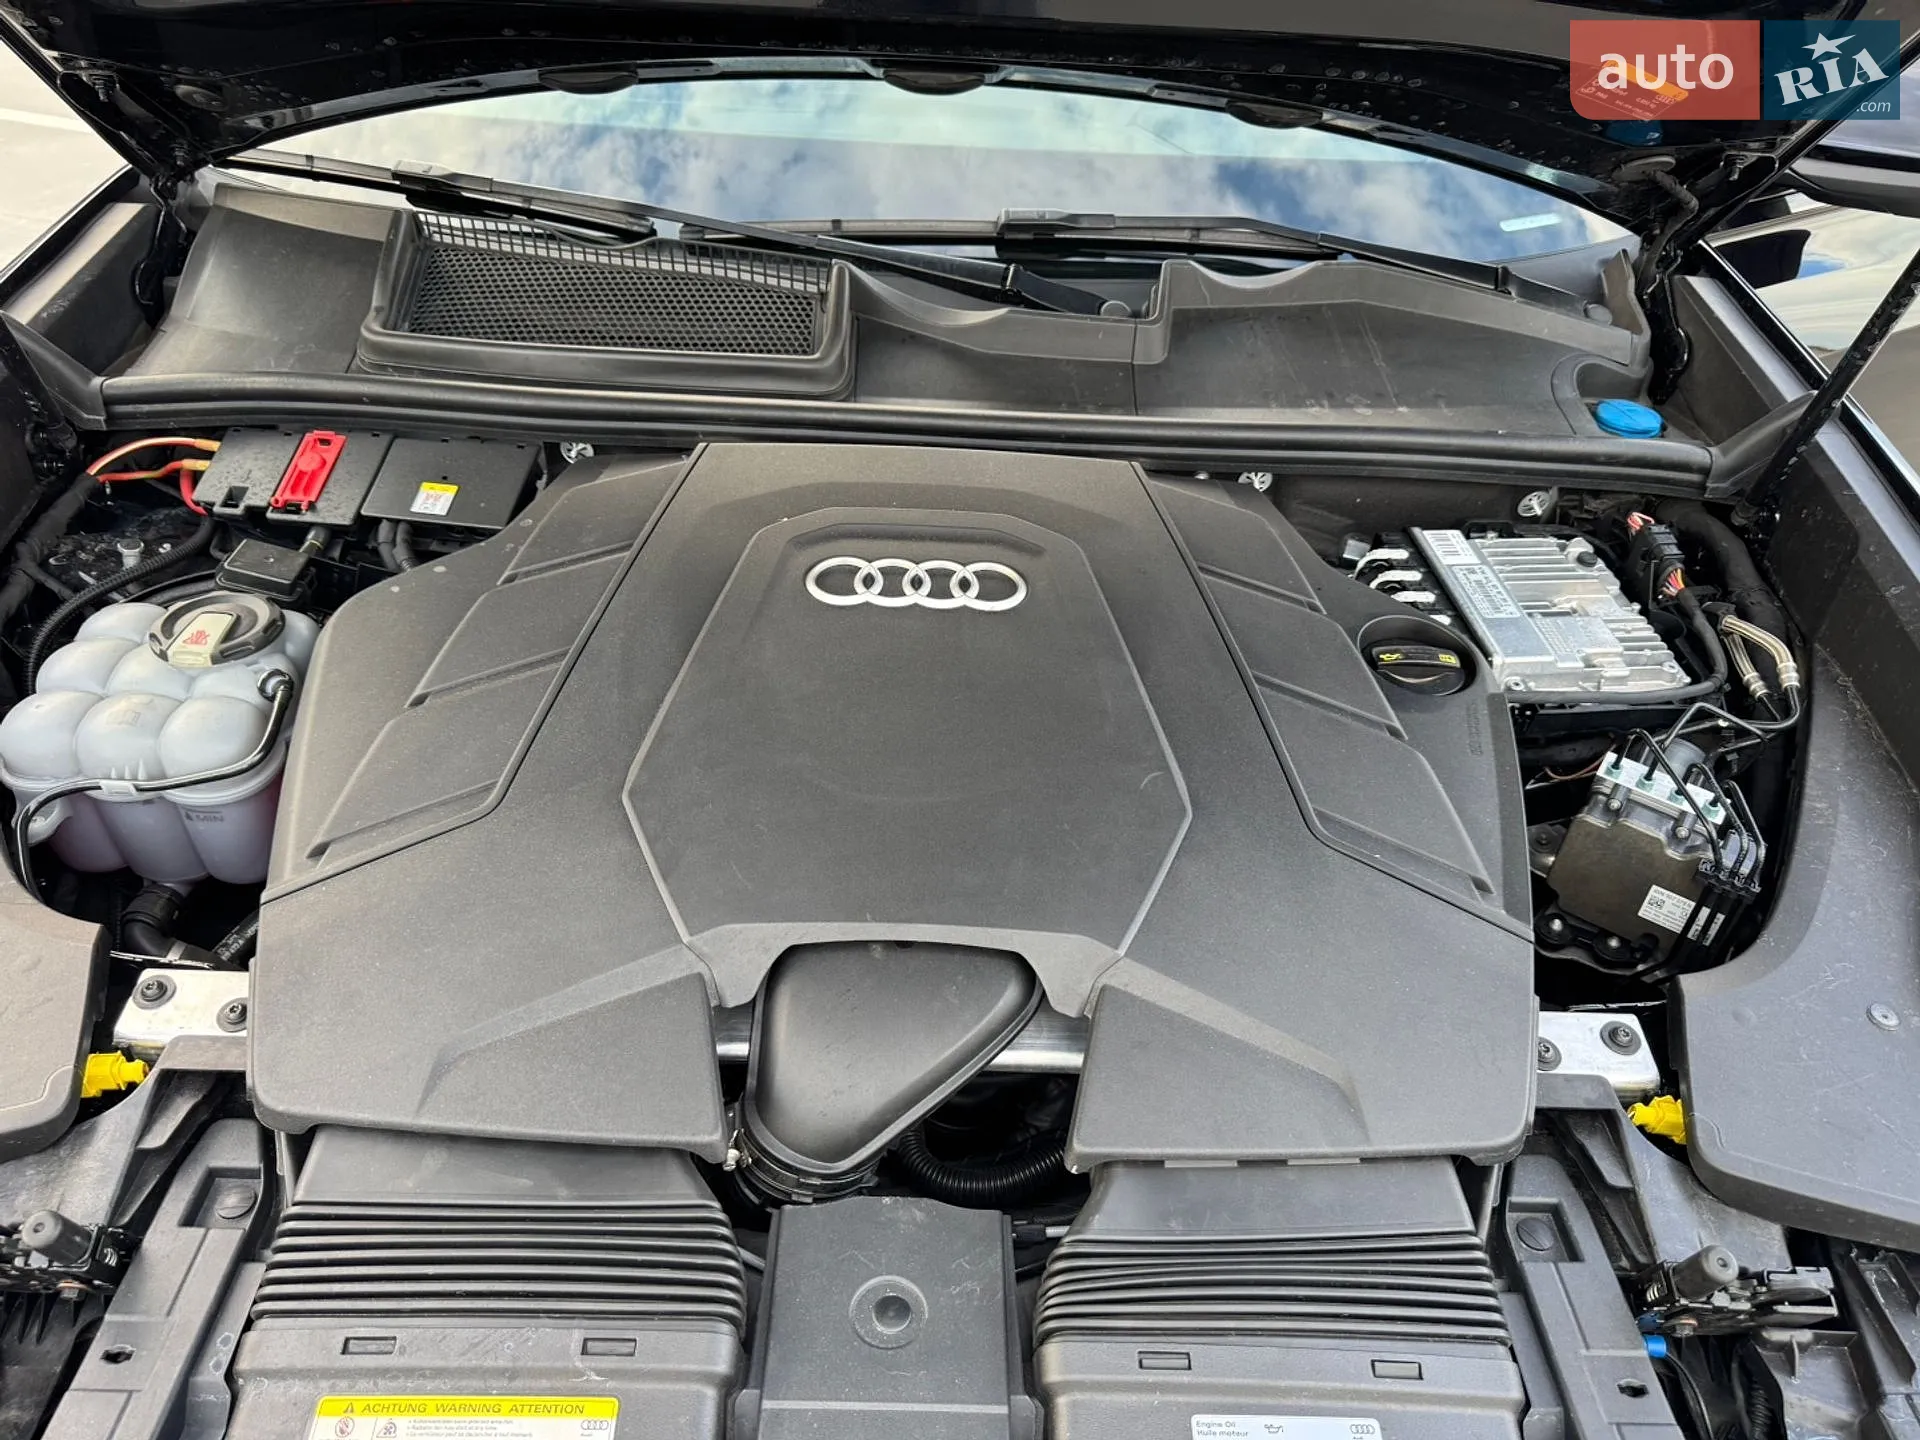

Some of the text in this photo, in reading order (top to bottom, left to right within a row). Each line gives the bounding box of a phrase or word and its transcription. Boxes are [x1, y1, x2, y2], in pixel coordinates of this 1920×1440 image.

[361, 1402, 585, 1415] ACHTUNG WARNING ATTENTION
[1195, 1420, 1223, 1429] Engine
